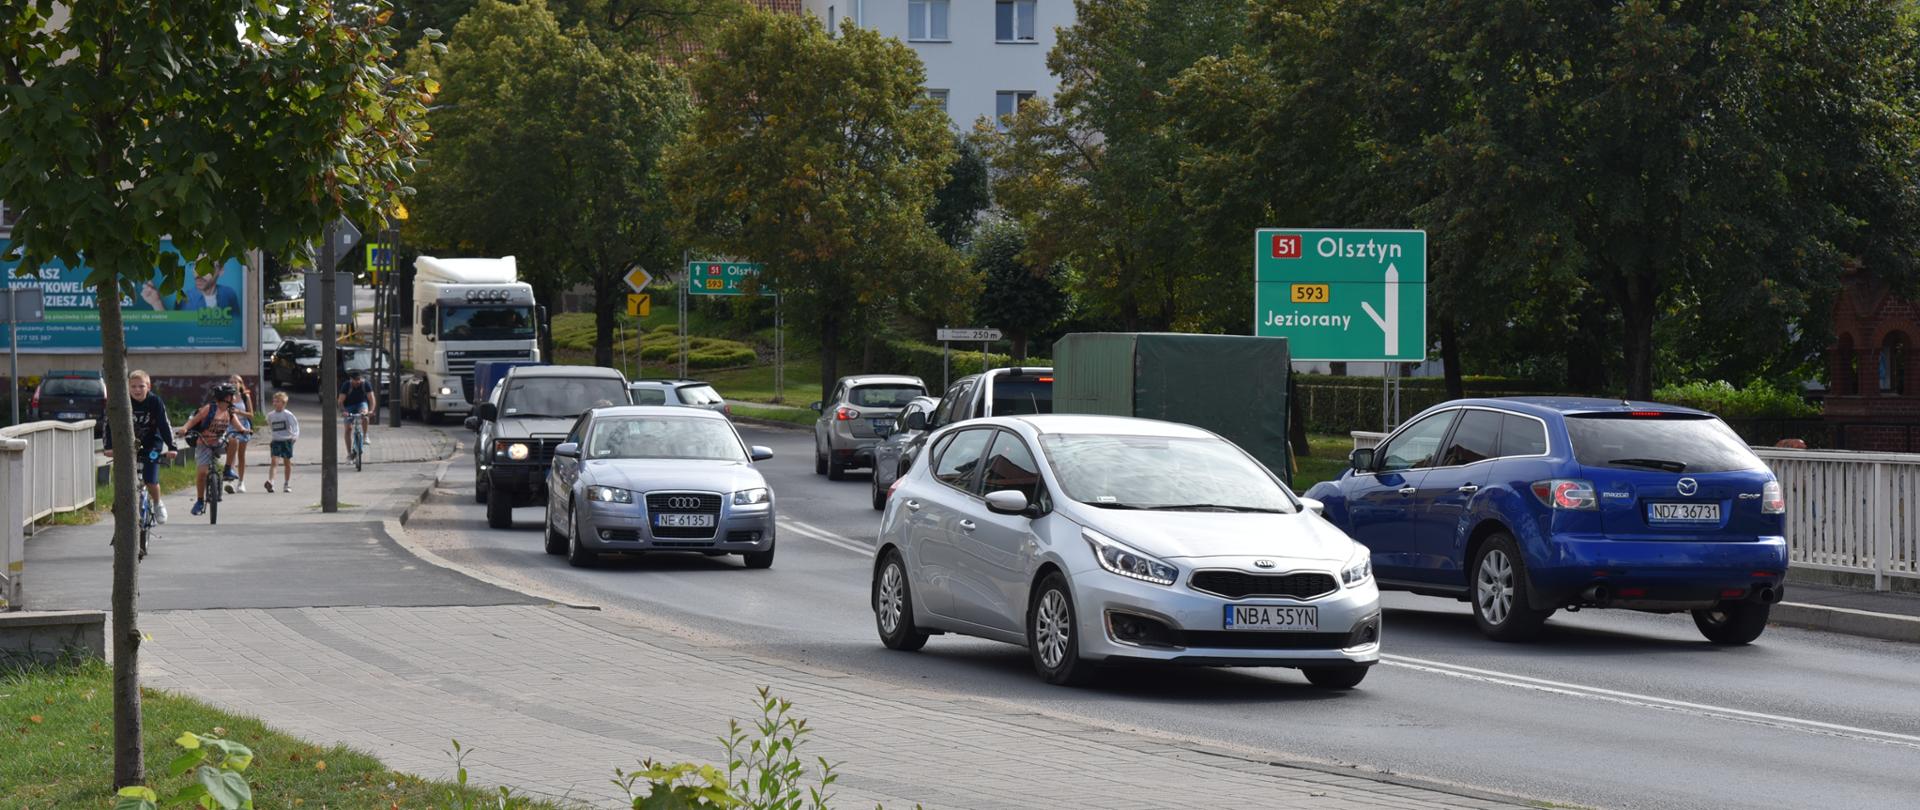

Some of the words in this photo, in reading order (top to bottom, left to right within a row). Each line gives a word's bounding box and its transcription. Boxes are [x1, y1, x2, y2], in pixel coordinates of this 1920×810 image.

[1278, 238, 1296, 255] 51
[1316, 237, 1402, 264] Olsztyn
[710, 266, 719, 274] 51
[728, 266, 760, 278] Olszty
[708, 280, 722, 288] 593
[1296, 287, 1323, 300] 593
[80, 295, 93, 308] JĄ
[199, 306, 232, 319] MOC
[1264, 310, 1351, 331] Jeziorany
[973, 331, 988, 339] 250
[1654, 504, 1677, 519] NDZ
[1681, 504, 1718, 520] 36731
[661, 514, 675, 526] NE
[678, 515, 710, 526] 6135J
[1256, 560, 1274, 568] KIA
[1236, 607, 1270, 625] NBA
[1277, 608, 1314, 625] 55YN
